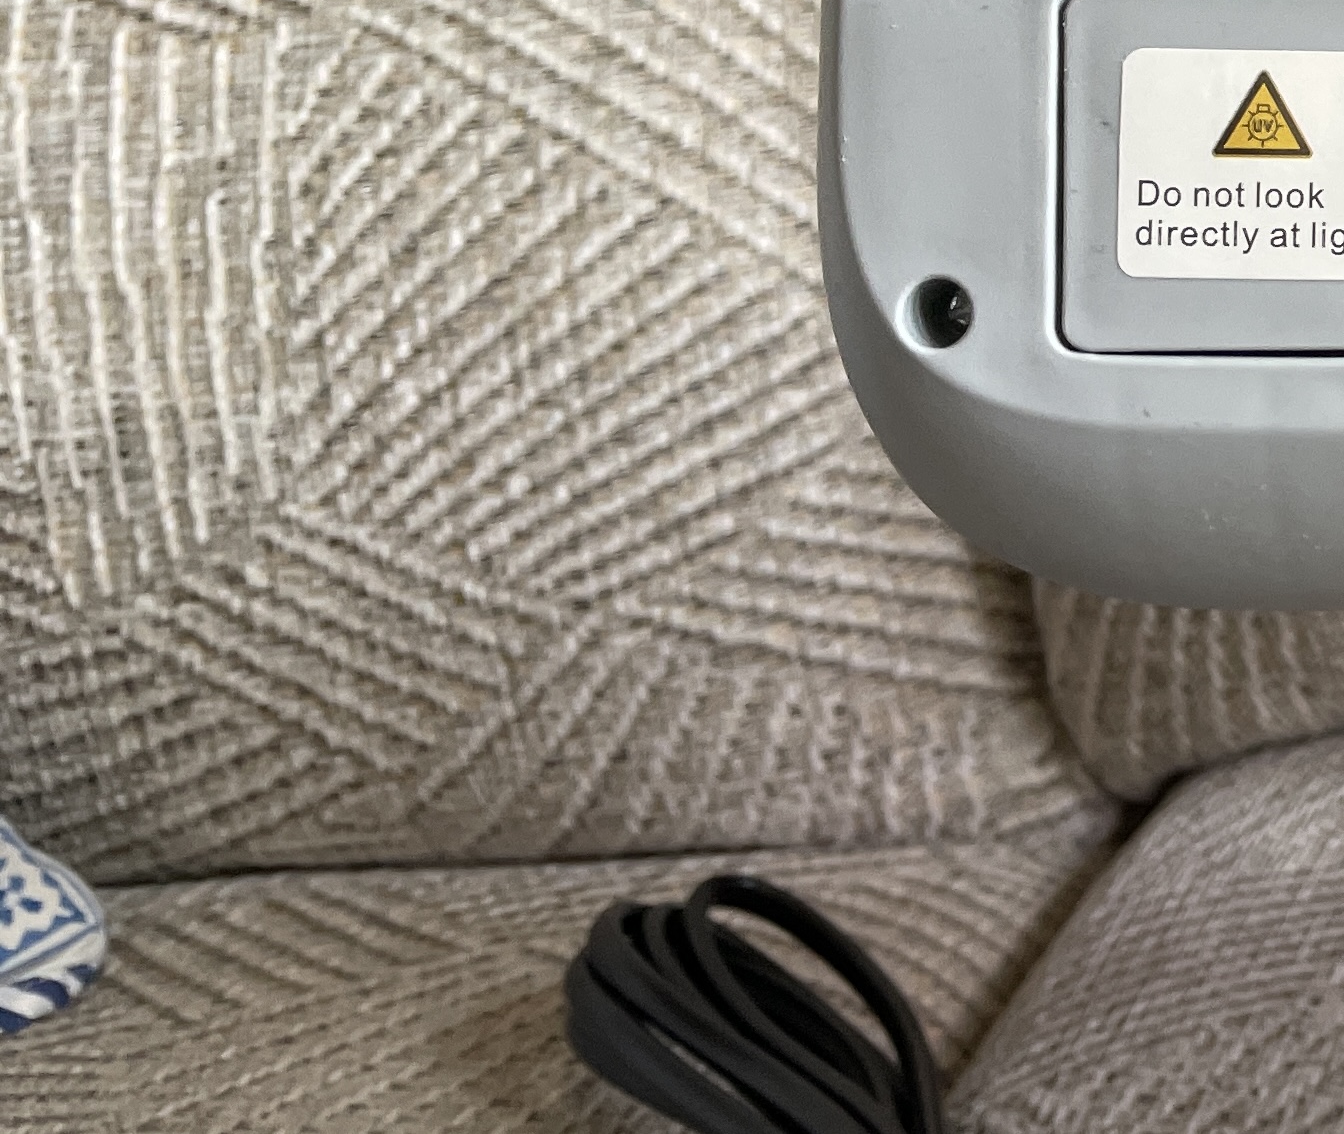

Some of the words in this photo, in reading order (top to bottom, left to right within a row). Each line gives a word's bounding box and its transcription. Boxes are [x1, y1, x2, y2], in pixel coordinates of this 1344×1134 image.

[1253, 119, 1275, 133] UV
[1137, 179, 1182, 207] Do
[1193, 182, 1245, 208] not
[1256, 182, 1325, 209] look
[1135, 219, 1259, 255] directly
[1270, 222, 1301, 249] at
